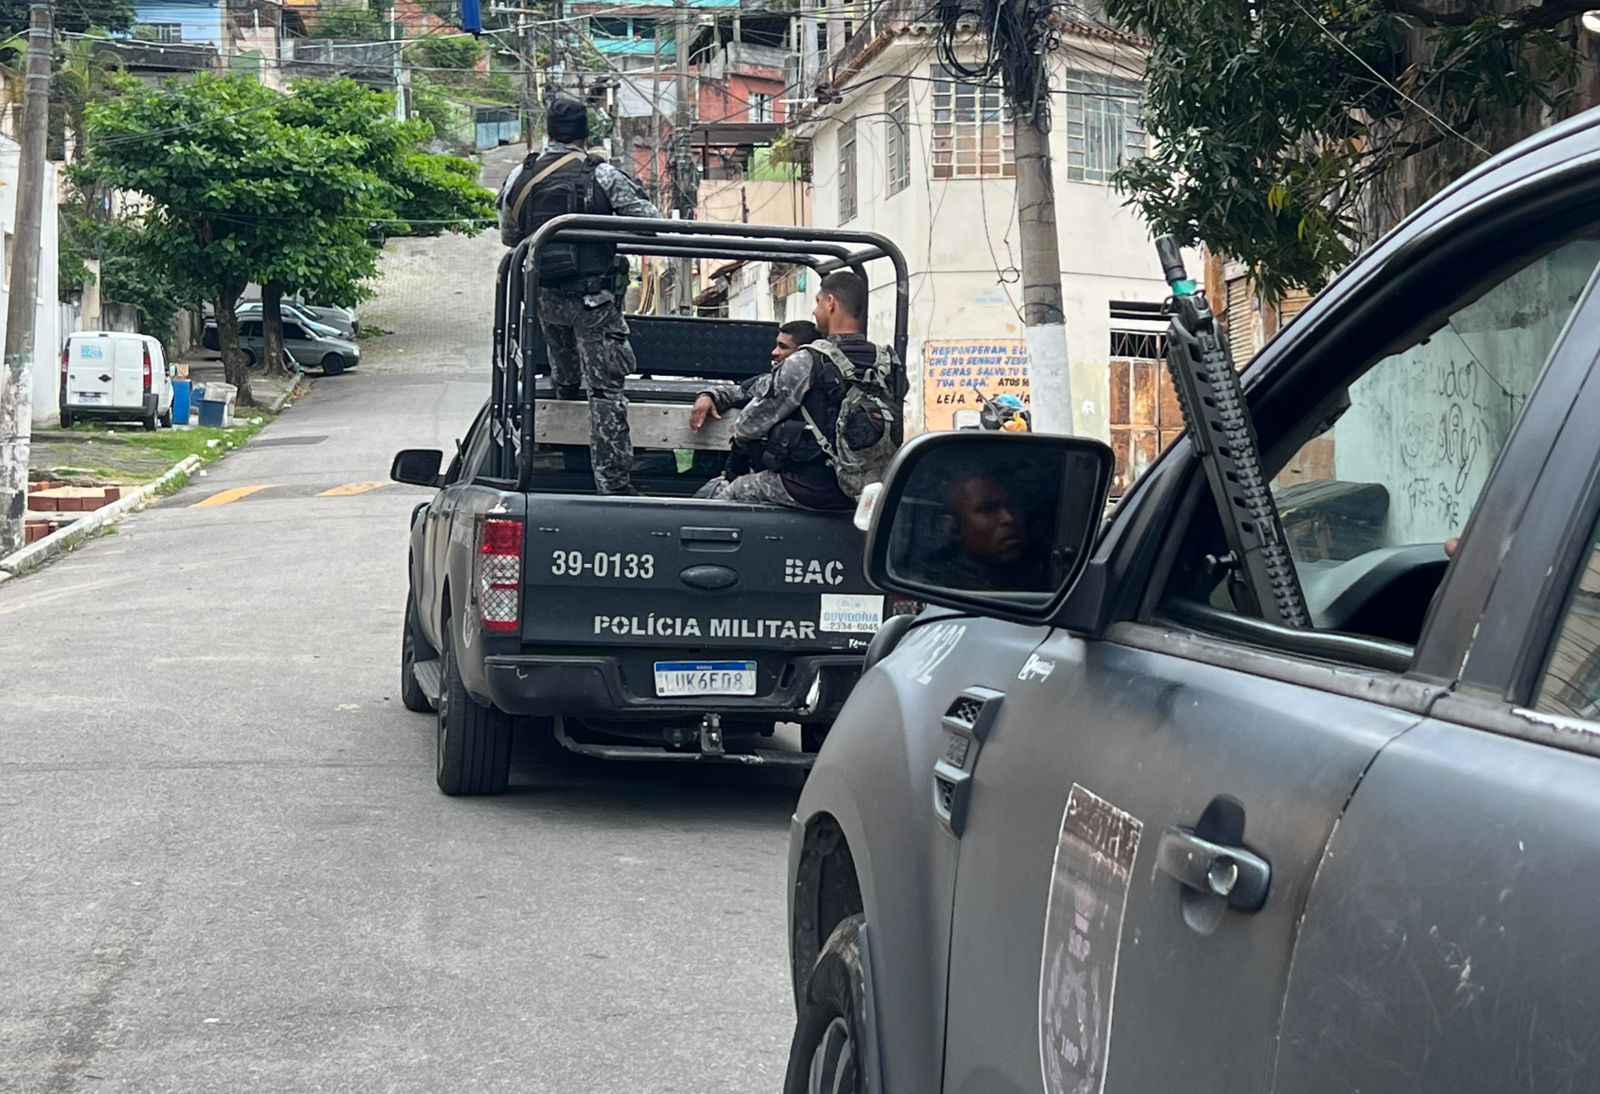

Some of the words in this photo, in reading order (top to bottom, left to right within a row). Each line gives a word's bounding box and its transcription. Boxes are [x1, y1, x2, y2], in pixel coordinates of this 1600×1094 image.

[951, 357, 964, 366] NO
[966, 356, 1002, 365] SENHOR
[929, 368, 935, 377] E
[936, 379, 955, 388] TUA
[998, 378, 1020, 387] ATOS
[552, 550, 655, 579] 39-0133
[785, 558, 844, 585] BAC
[823, 611, 879, 622] OUVIDORIA
[594, 612, 702, 637] POLÍCIA
[709, 618, 817, 640] MILITAR
